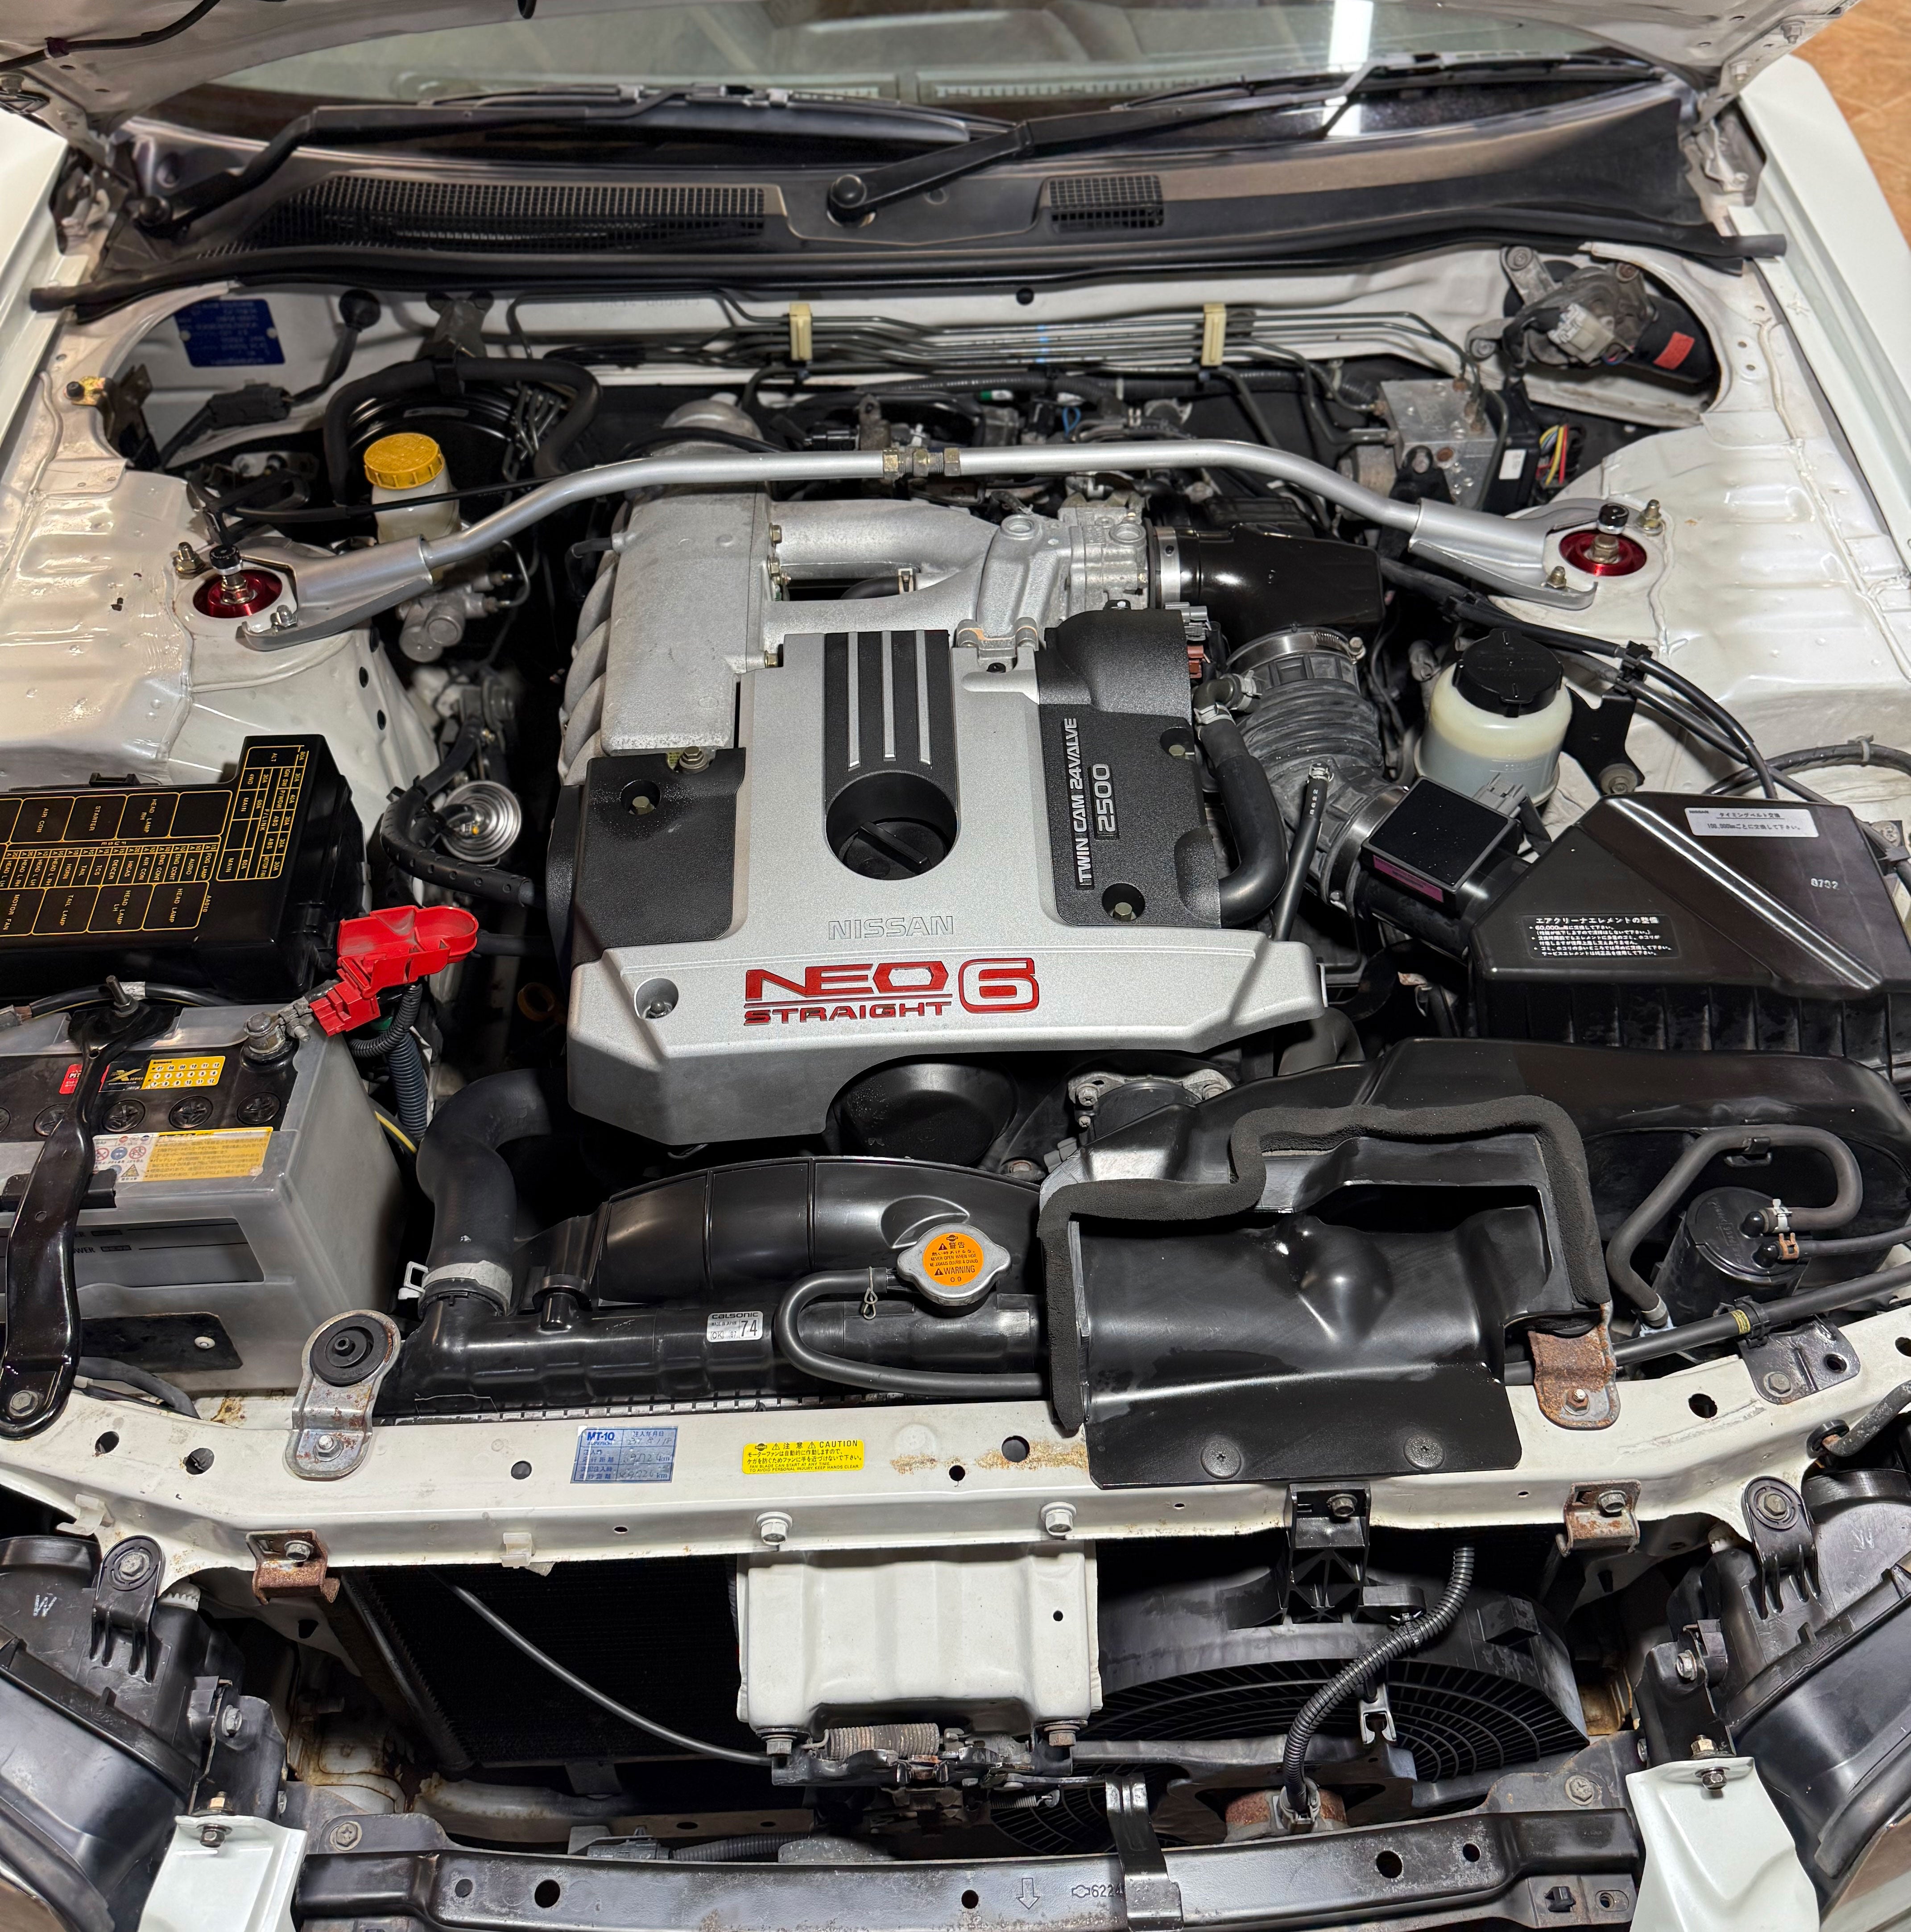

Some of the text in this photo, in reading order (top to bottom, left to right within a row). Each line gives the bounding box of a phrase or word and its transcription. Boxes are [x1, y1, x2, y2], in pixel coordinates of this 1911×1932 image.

[241, 797, 249, 812] MAIN
[1064, 718, 1092, 885] TWIN CAM 24VALVE
[1092, 764, 1116, 833] 2500
[36, 808, 49, 833] AIR CON
[89, 805, 101, 831] STARTER
[144, 799, 157, 833] HEAD LAMP
[260, 809, 270, 831] F/LINK
[266, 838, 274, 850] ABS
[79, 865, 87, 877] TAIL
[138, 868, 147, 880] CON
[153, 854, 166, 881] ENG CONT
[169, 854, 182, 880] ENG CONT
[186, 858, 195, 875] AUDIO
[201, 853, 212, 879] FOG LAMP
[225, 858, 234, 873] MAIN
[3, 894, 21, 930] MOTOR FAN
[59, 894, 74, 926] TAIL LAMP
[113, 904, 120, 912] LH
[116, 890, 131, 925] HEAD LAMP
[169, 888, 183, 923] HEAD LAMP
[828, 916, 954, 940] NISSAN
[745, 957, 1040, 1014] NEO 6
[744, 1001, 952, 1026] STRAIGHT
[943, 1265, 976, 1275] WARNING
[712, 1331, 722, 1339] OK
[741, 1320, 757, 1337] 74
[587, 1431, 615, 1441] MT-10
[819, 1440, 858, 1448] CAUTION
[1091, 1885, 1126, 1898] 6224
